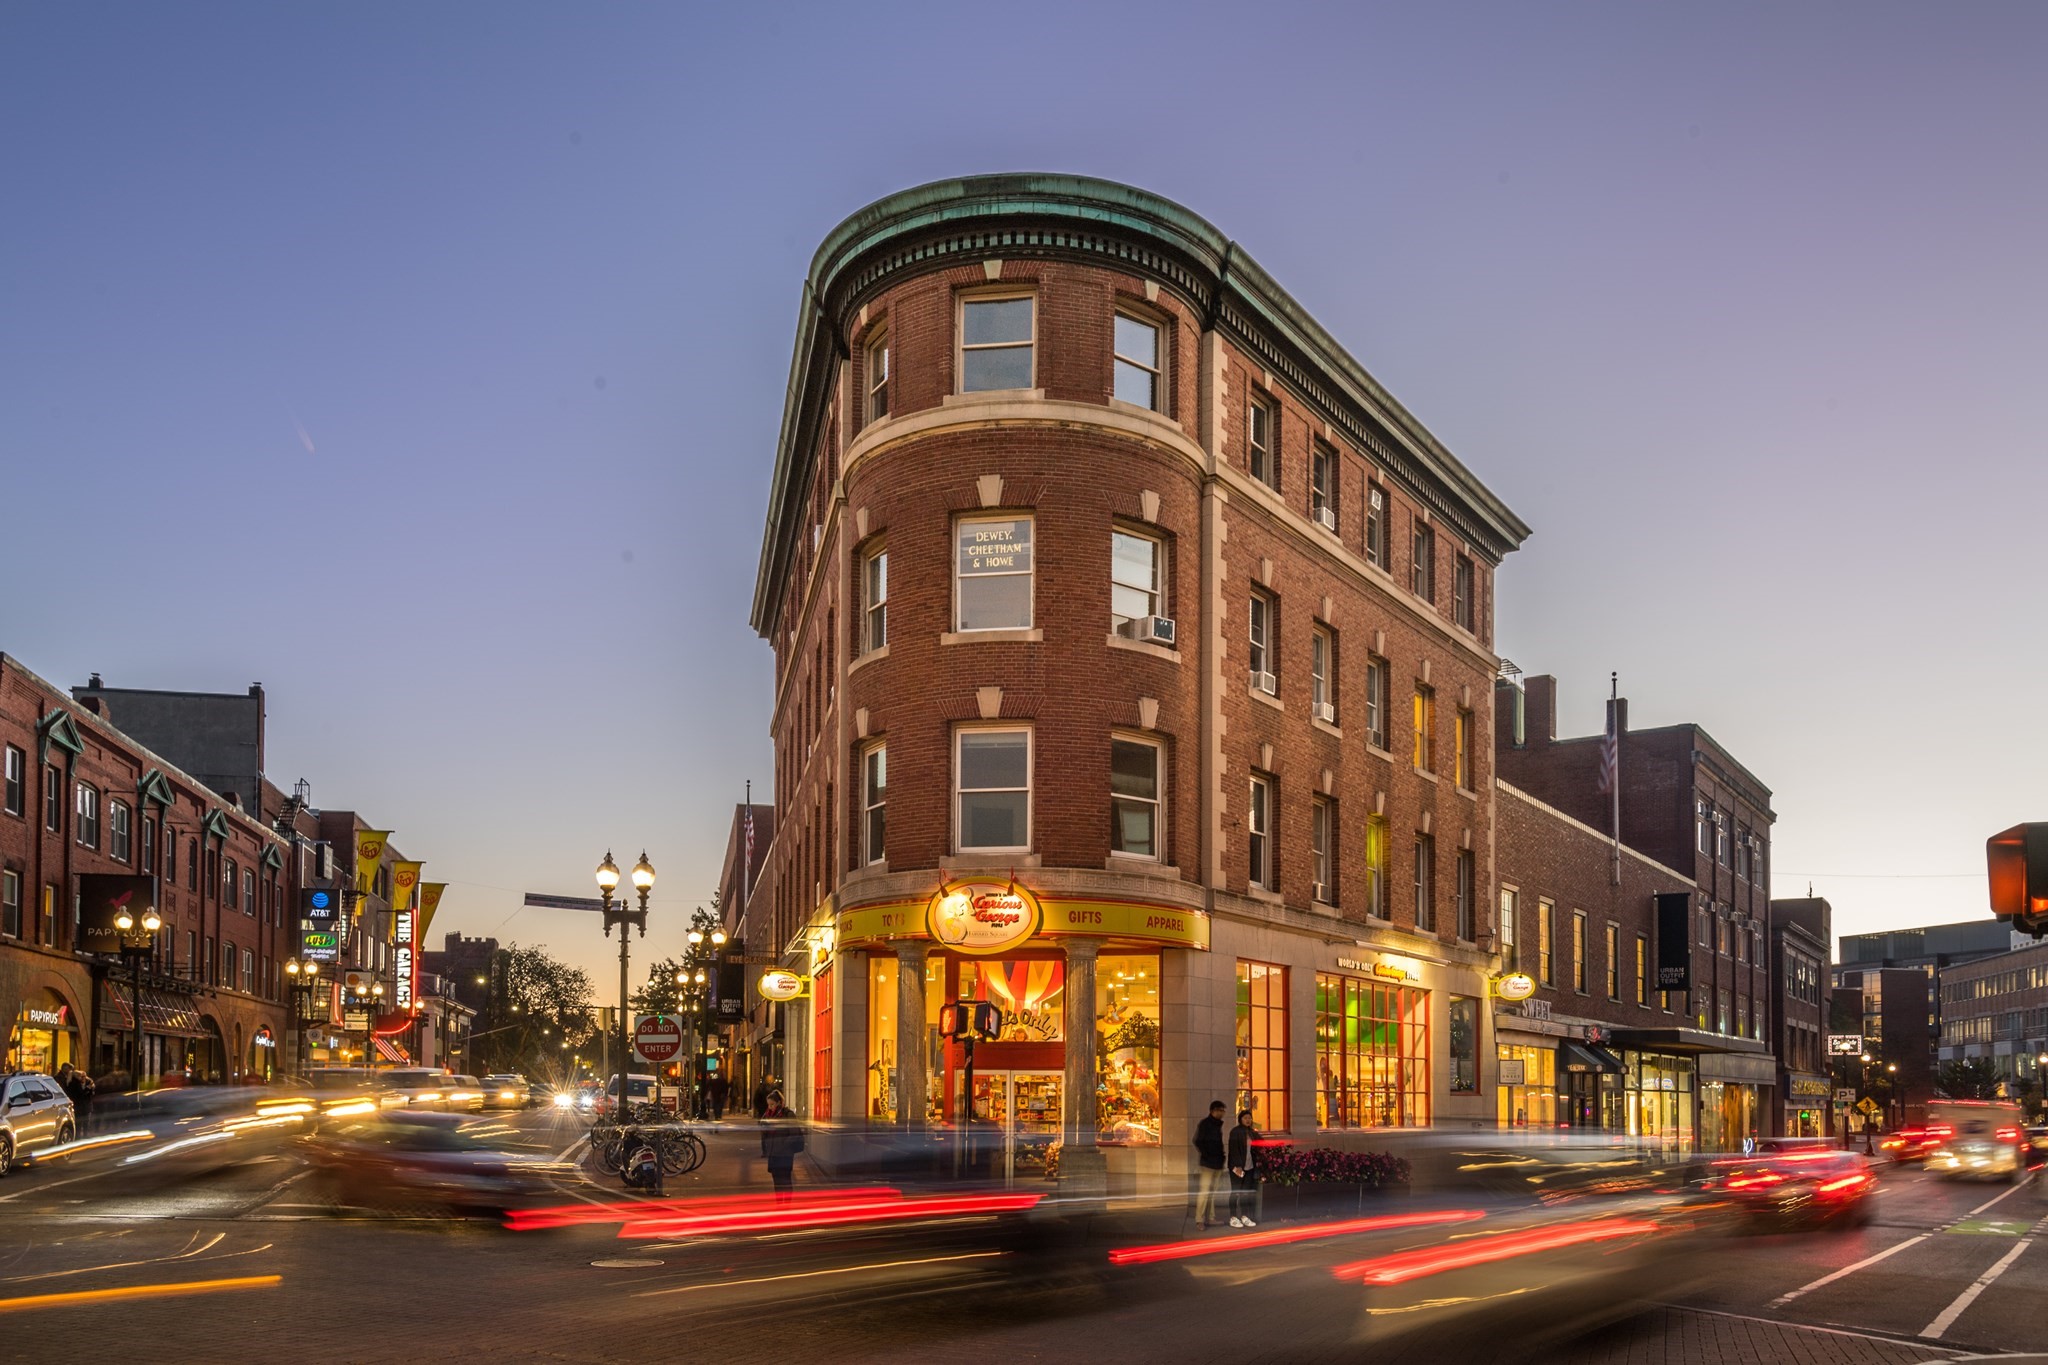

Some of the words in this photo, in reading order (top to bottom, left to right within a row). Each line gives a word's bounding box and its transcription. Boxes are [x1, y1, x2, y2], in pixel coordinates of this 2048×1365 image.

[968, 544, 1022, 556] CHEETHAM
[973, 559, 980, 568] &
[986, 557, 1014, 568] HOWE
[974, 896, 1022, 910] Curious
[310, 909, 331, 917] AT&T
[975, 910, 1020, 926] George
[1068, 910, 1102, 924] GIFTS
[397, 911, 412, 943] THE
[1146, 915, 1185, 932] APPAREL
[87, 928, 146, 938] PAPYUS
[1522, 998, 1552, 1020] SWEET
[30, 1009, 59, 1025] PAPYRUS
[641, 1025, 653, 1033] DO
[658, 1025, 674, 1033] NOT
[644, 1045, 672, 1053] ENTER
[1840, 1091, 1848, 1099] P
